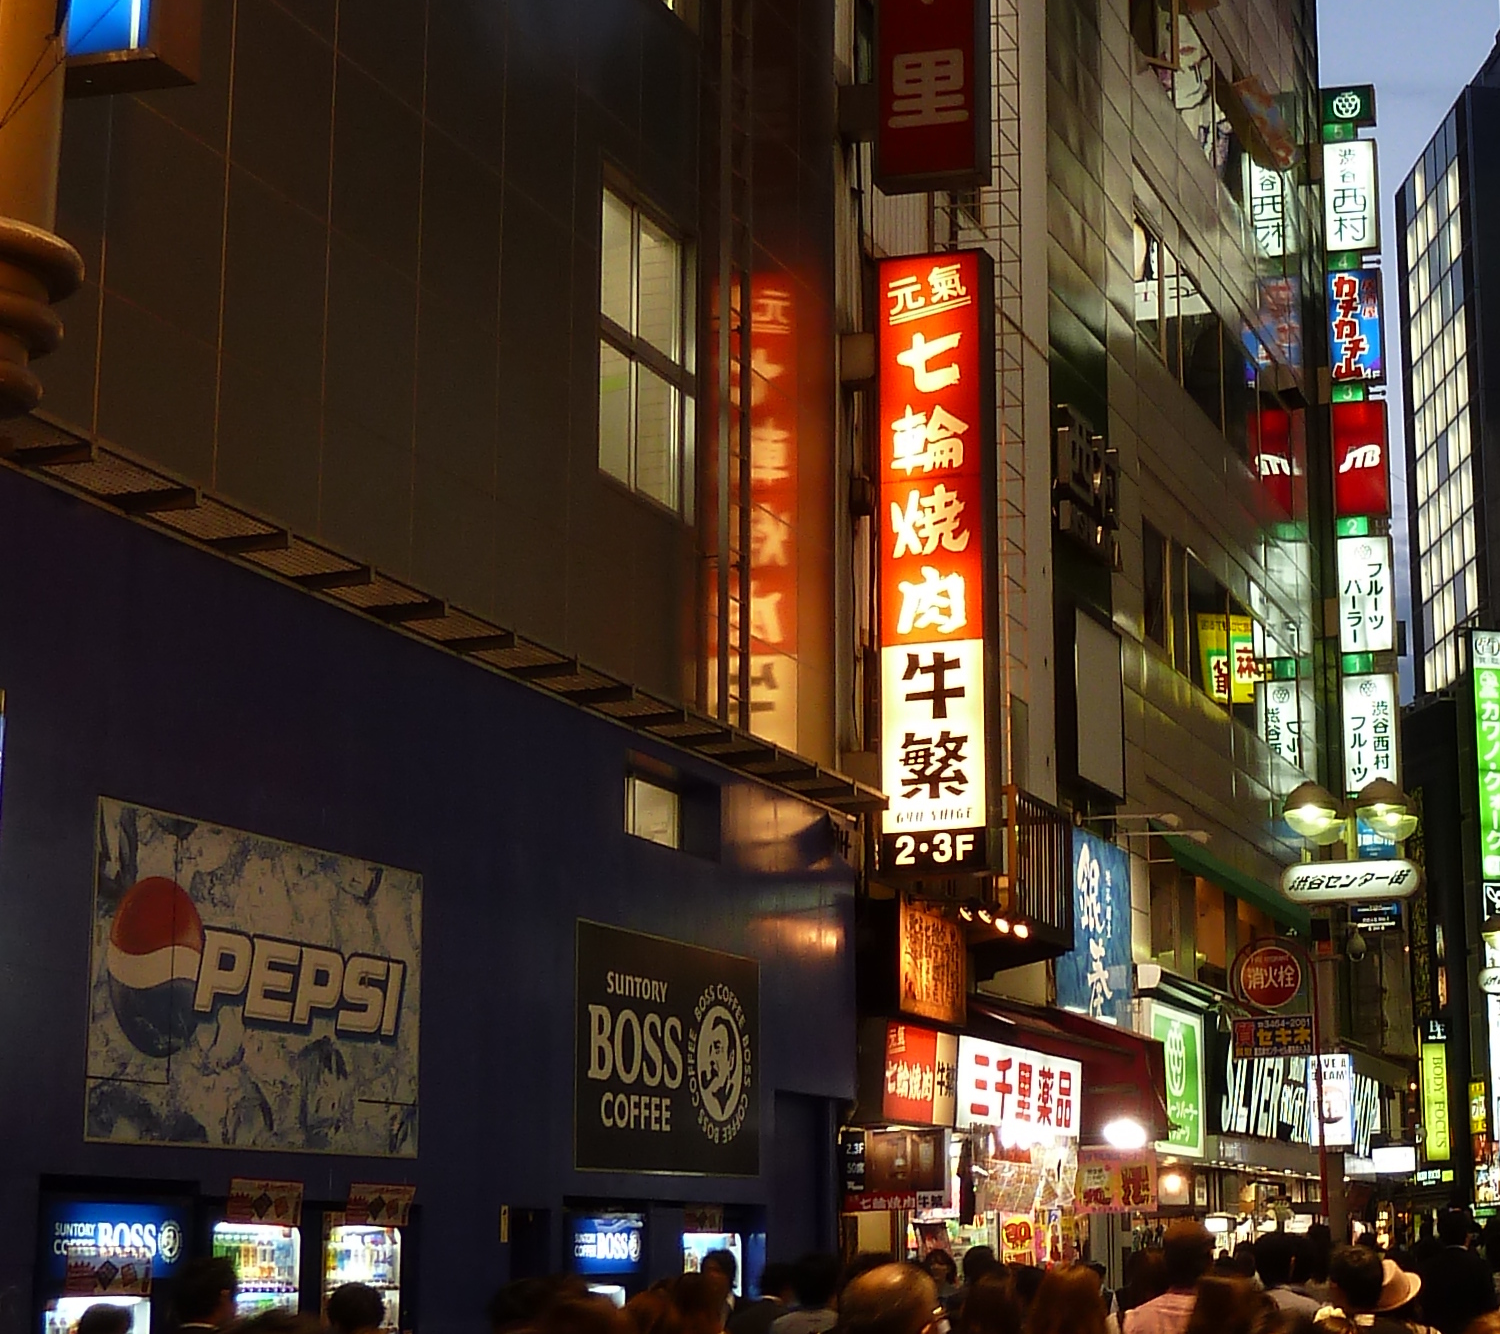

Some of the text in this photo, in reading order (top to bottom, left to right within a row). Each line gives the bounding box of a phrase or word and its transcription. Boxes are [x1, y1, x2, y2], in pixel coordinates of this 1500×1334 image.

[1333, 147, 1368, 244] 渋谷西村
[1332, 273, 1369, 381] カチカチ山
[888, 329, 973, 636] 七輪焼肉
[1339, 444, 1381, 474] JTB
[1344, 578, 1363, 644] パーラー
[1367, 562, 1385, 631] フルーツ
[900, 652, 969, 800] 牛繁
[1350, 715, 1368, 783] フルーツ
[1371, 700, 1390, 770] 渋谷西村
[1289, 870, 1411, 893] 渋谷センター街
[195, 926, 405, 1041] PEPSI
[694, 984, 716, 1021] BOSS
[717, 983, 747, 1030] COFFEE
[1247, 965, 1296, 990] 消火栓
[587, 1003, 684, 1090] BOSS
[687, 1027, 700, 1107] COFFEE
[742, 1034, 752, 1088] BOSS
[1257, 1026, 1311, 1046] セキネ
[1311, 1059, 1337, 1068] HVE
[601, 1091, 671, 1132] COFFEE
[885, 1058, 934, 1101] 七輪焼肉
[969, 1053, 1073, 1128] 三千里薬品
[1221, 1040, 1284, 1139] SILVER
[1432, 1056, 1447, 1149] BODY FOCUS
[55, 1221, 157, 1258] SUNTORY BOSS
[597, 1232, 629, 1259] BOSS
